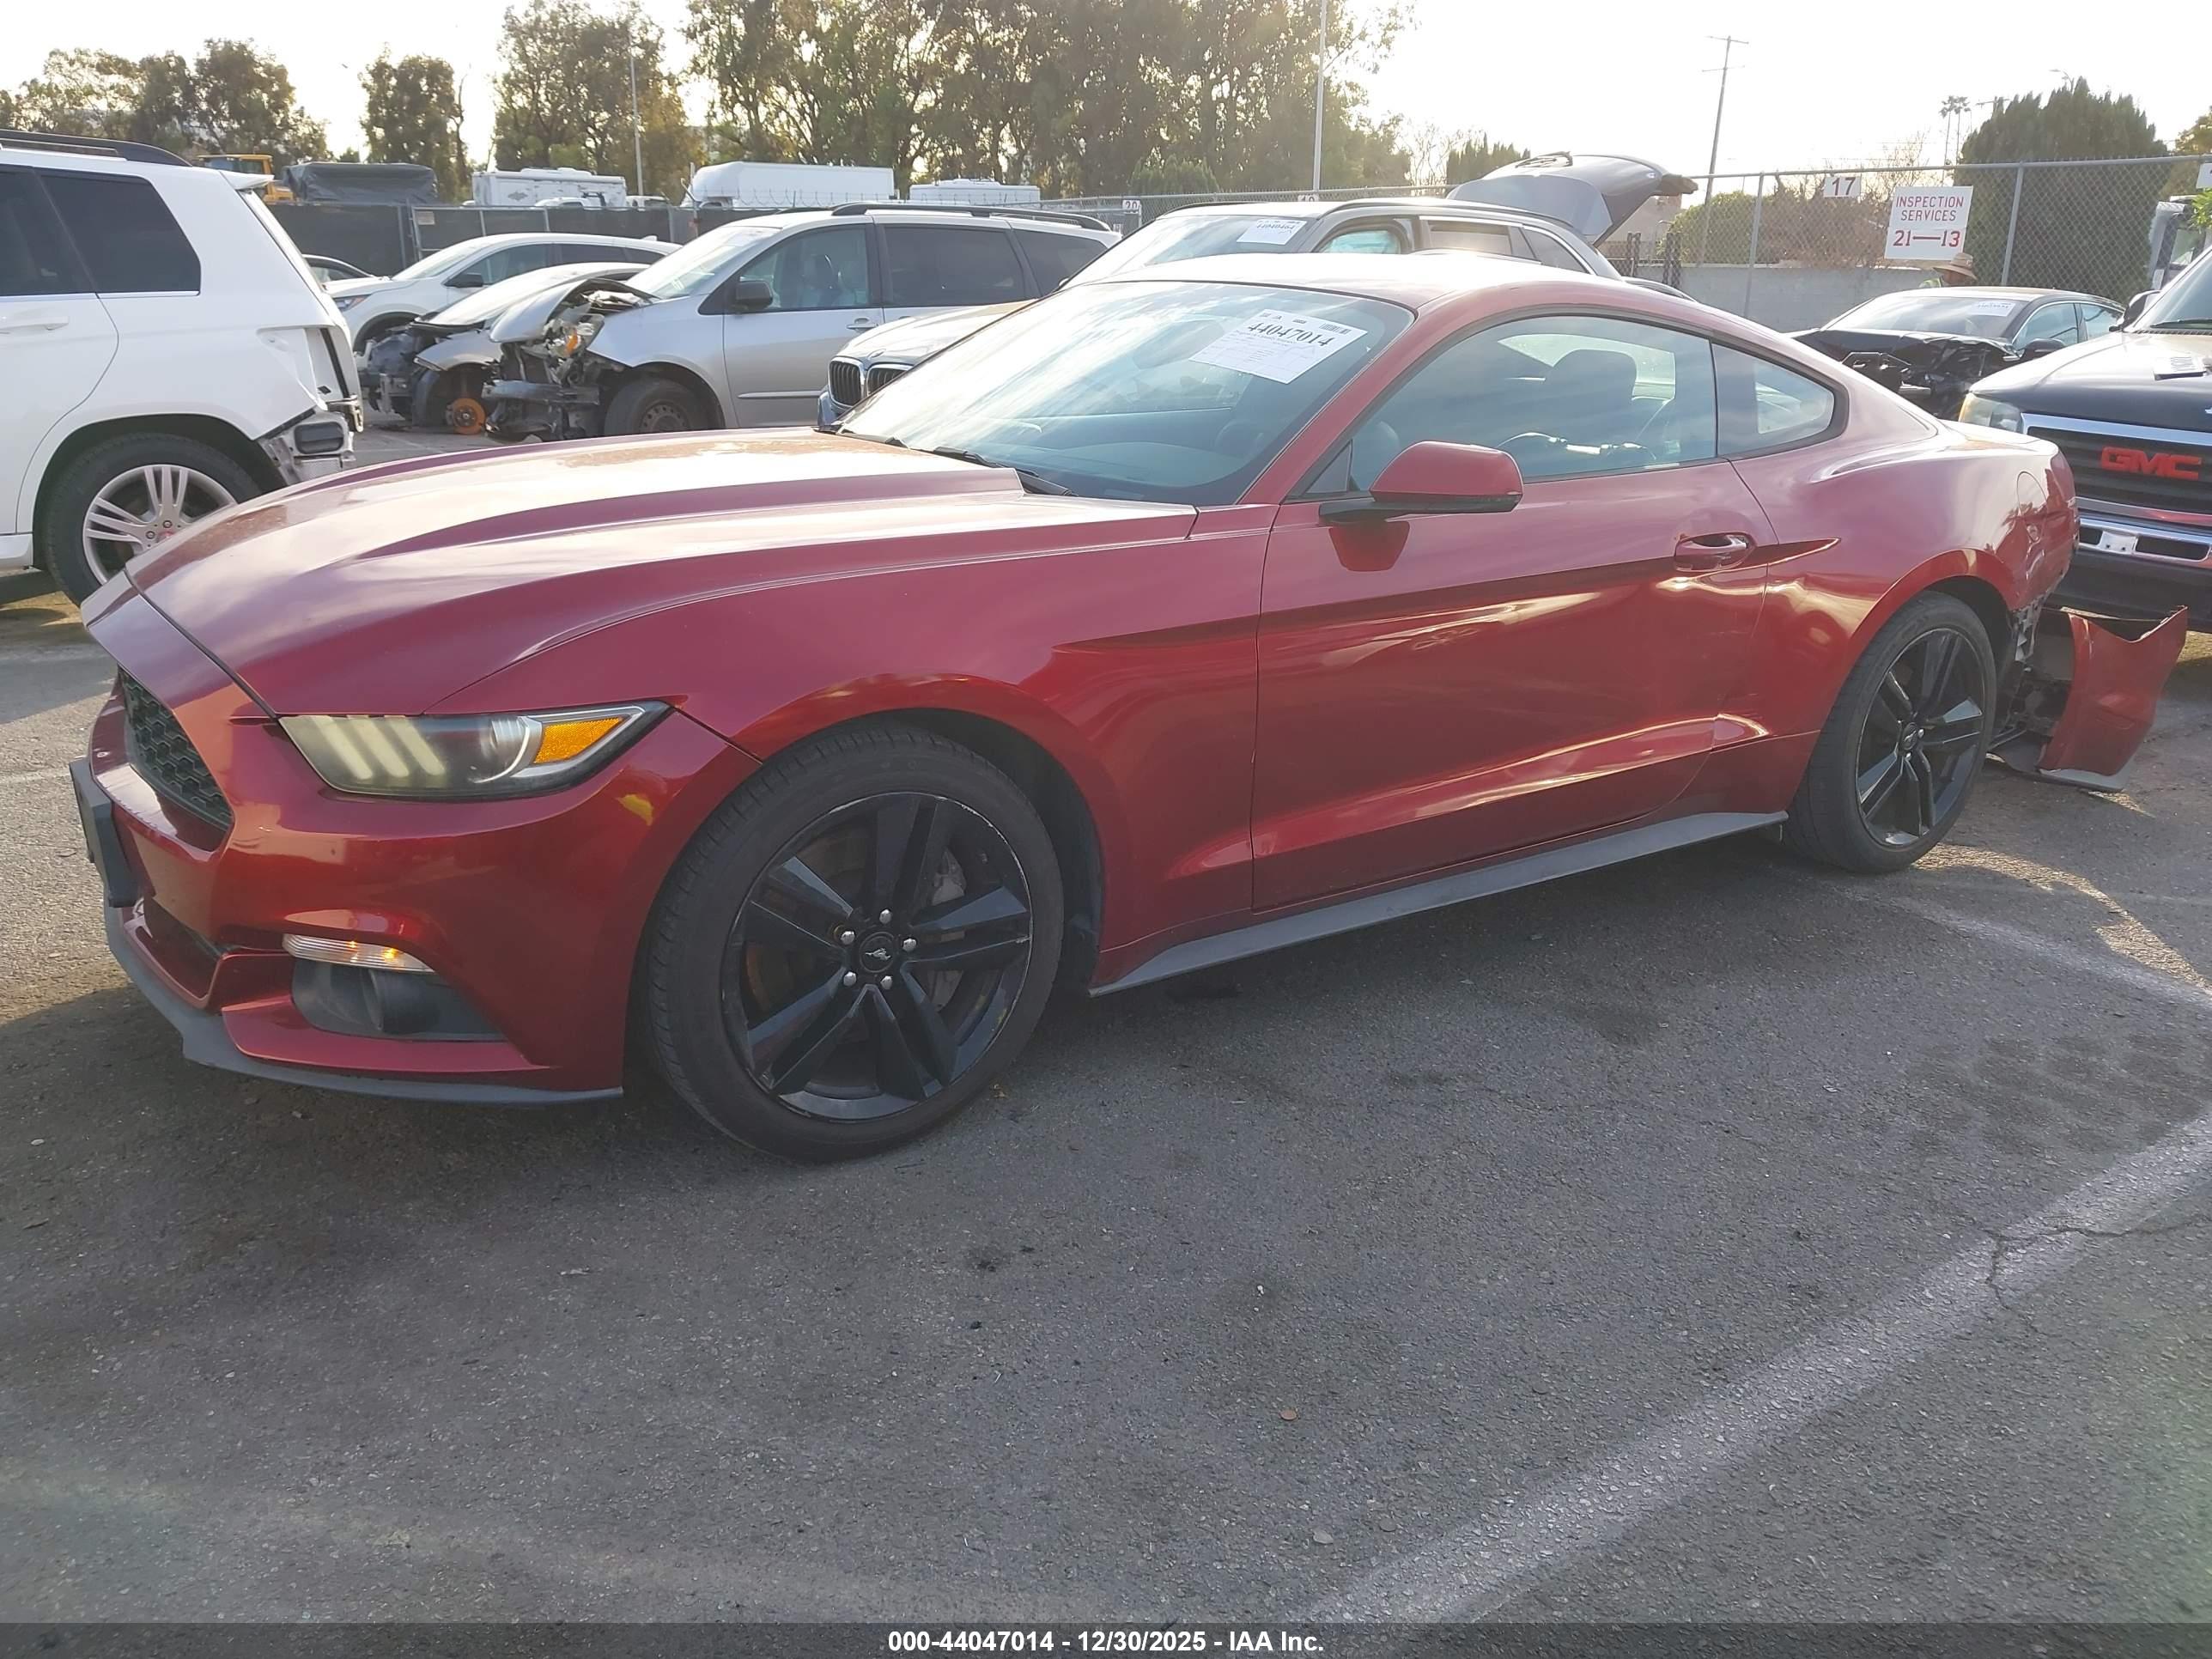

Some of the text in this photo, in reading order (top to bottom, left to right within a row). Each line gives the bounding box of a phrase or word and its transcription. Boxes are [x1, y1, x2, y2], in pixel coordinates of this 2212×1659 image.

[1832, 177, 1856, 196] 17
[1895, 196, 1965, 208] INSPECTION
[1900, 210, 1957, 222] SERVICES
[1248, 322, 1335, 347] 44047014
[2101, 446, 2202, 481] GMC
